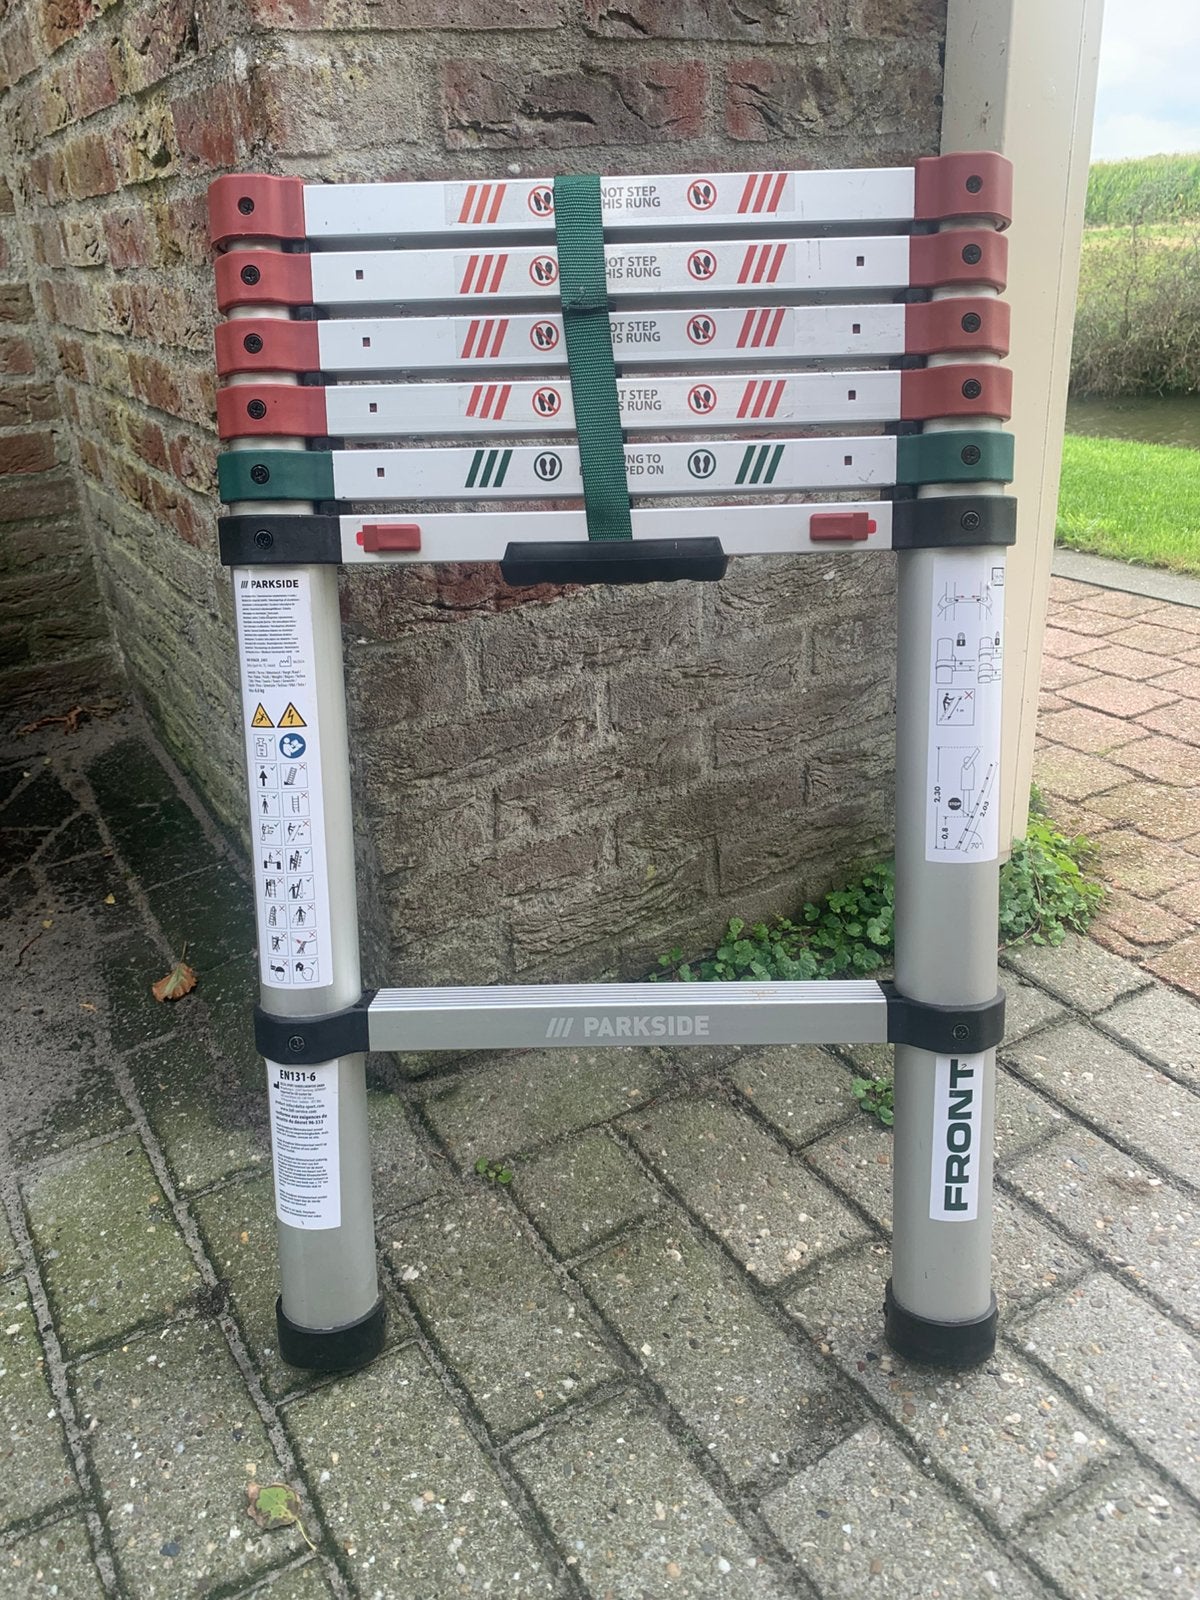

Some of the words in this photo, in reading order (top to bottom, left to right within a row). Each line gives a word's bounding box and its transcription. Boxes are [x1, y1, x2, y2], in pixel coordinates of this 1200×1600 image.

[627, 186, 656, 197] STEP
[602, 198, 622, 209] HIS
[626, 197, 661, 209] RUNG
[605, 257, 625, 267] OT
[628, 256, 657, 267] STEP
[627, 267, 661, 278] RUNG
[609, 322, 625, 332] OT
[628, 321, 657, 332] STEP
[626, 332, 661, 343] RUNG
[629, 390, 658, 400] STEP
[627, 400, 662, 411] RUNG
[625, 454, 644, 464] NG
[646, 454, 661, 464] TO
[647, 465, 664, 475] ON
[251, 579, 299, 589] PARKSIDE
[583, 1015, 710, 1037] PARKSIDE
[280, 1069, 316, 1082] EN131-6
[944, 1059, 974, 1211] FRONT
